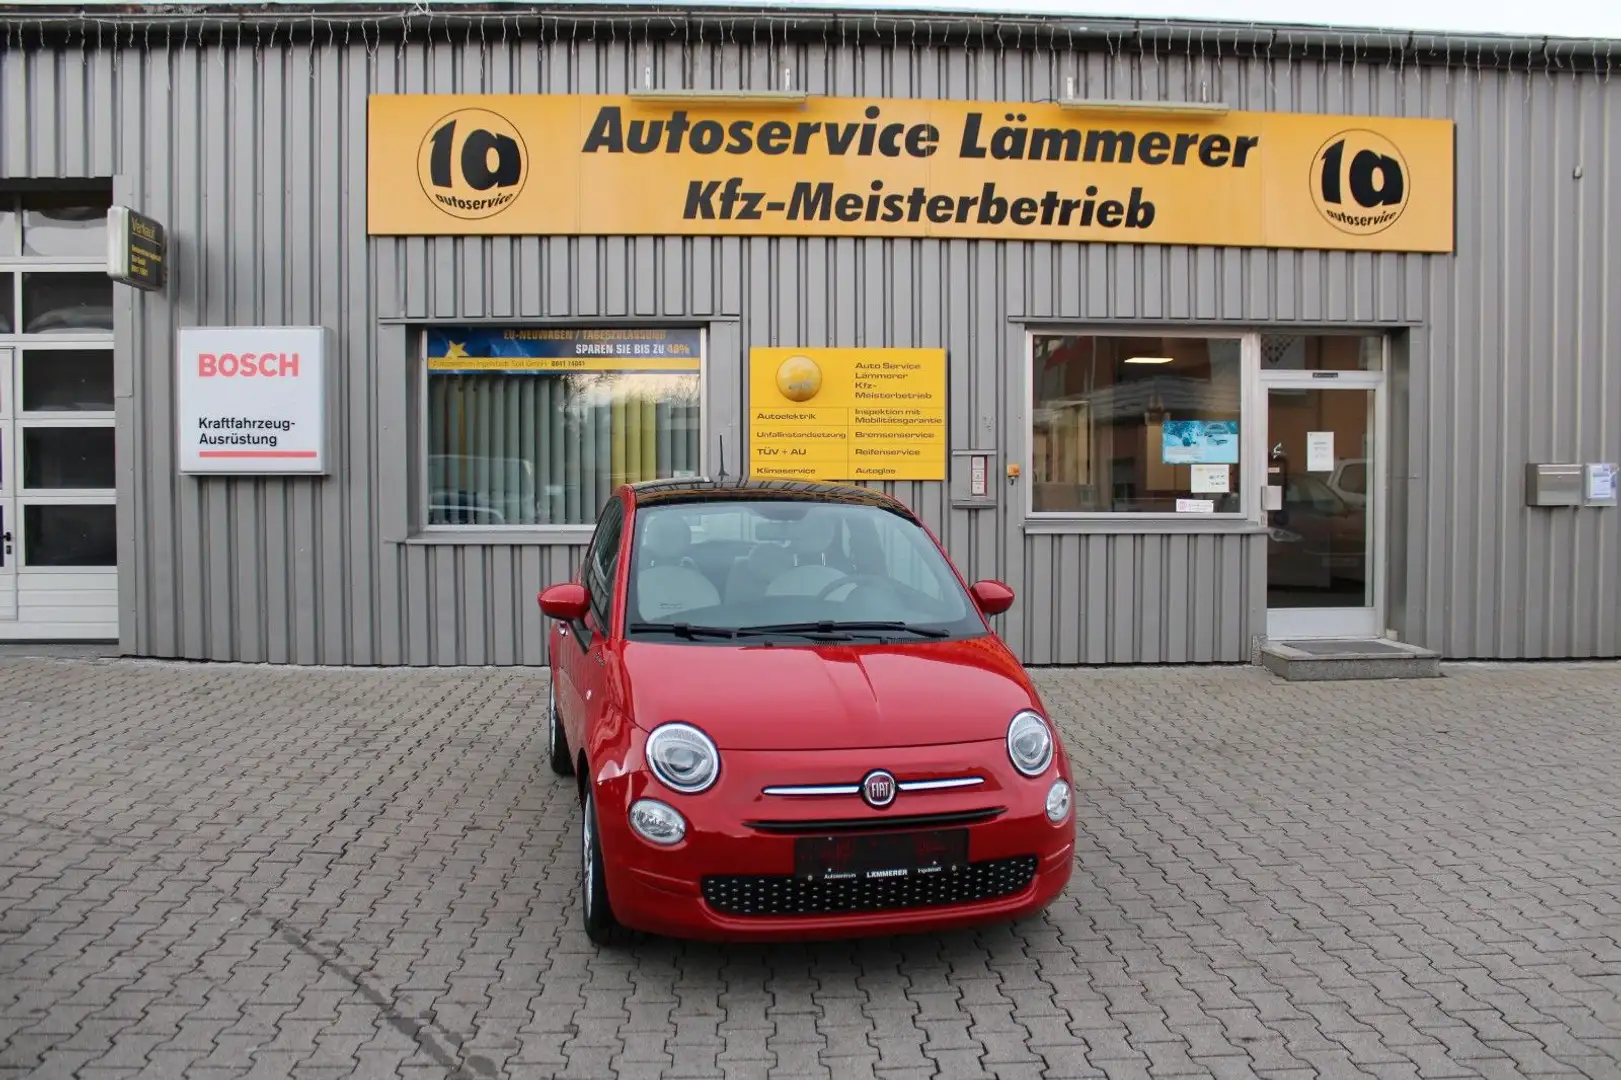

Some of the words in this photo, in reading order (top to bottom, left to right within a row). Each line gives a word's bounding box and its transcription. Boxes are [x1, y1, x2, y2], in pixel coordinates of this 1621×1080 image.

[582, 105, 940, 158] Autoservice
[960, 112, 1258, 169] Lämmerer
[429, 118, 522, 191] 1a
[1320, 138, 1404, 208] 1a
[435, 192, 514, 210] autoservice
[682, 177, 1156, 230] Kfz-Meisterbetrieb
[1326, 210, 1397, 226] autoservice
[575, 343, 613, 355] SPAREN
[615, 343, 632, 354] SIE
[634, 343, 650, 354] BIS
[652, 343, 664, 354] ZU
[198, 353, 299, 378] BOSCH
[855, 362, 881, 370] Auto
[882, 362, 921, 370] Service
[855, 392, 932, 400] Meisterbetrieb
[757, 413, 816, 421] Autoelektrik
[855, 408, 904, 417] Inspektion
[905, 408, 921, 416] mit
[198, 417, 296, 431] Kraftfahrzeug-
[199, 432, 277, 447] Ausrüstung
[756, 431, 847, 440] Unfallinstandsetzung
[855, 431, 935, 439] Bremsenservice
[757, 446, 779, 456] TÜV
[790, 448, 807, 456] AU
[855, 448, 921, 456] Reifenservice
[756, 467, 816, 475] Klimaservice
[855, 467, 896, 476] Autoglas
[871, 781, 890, 798] FIAT
